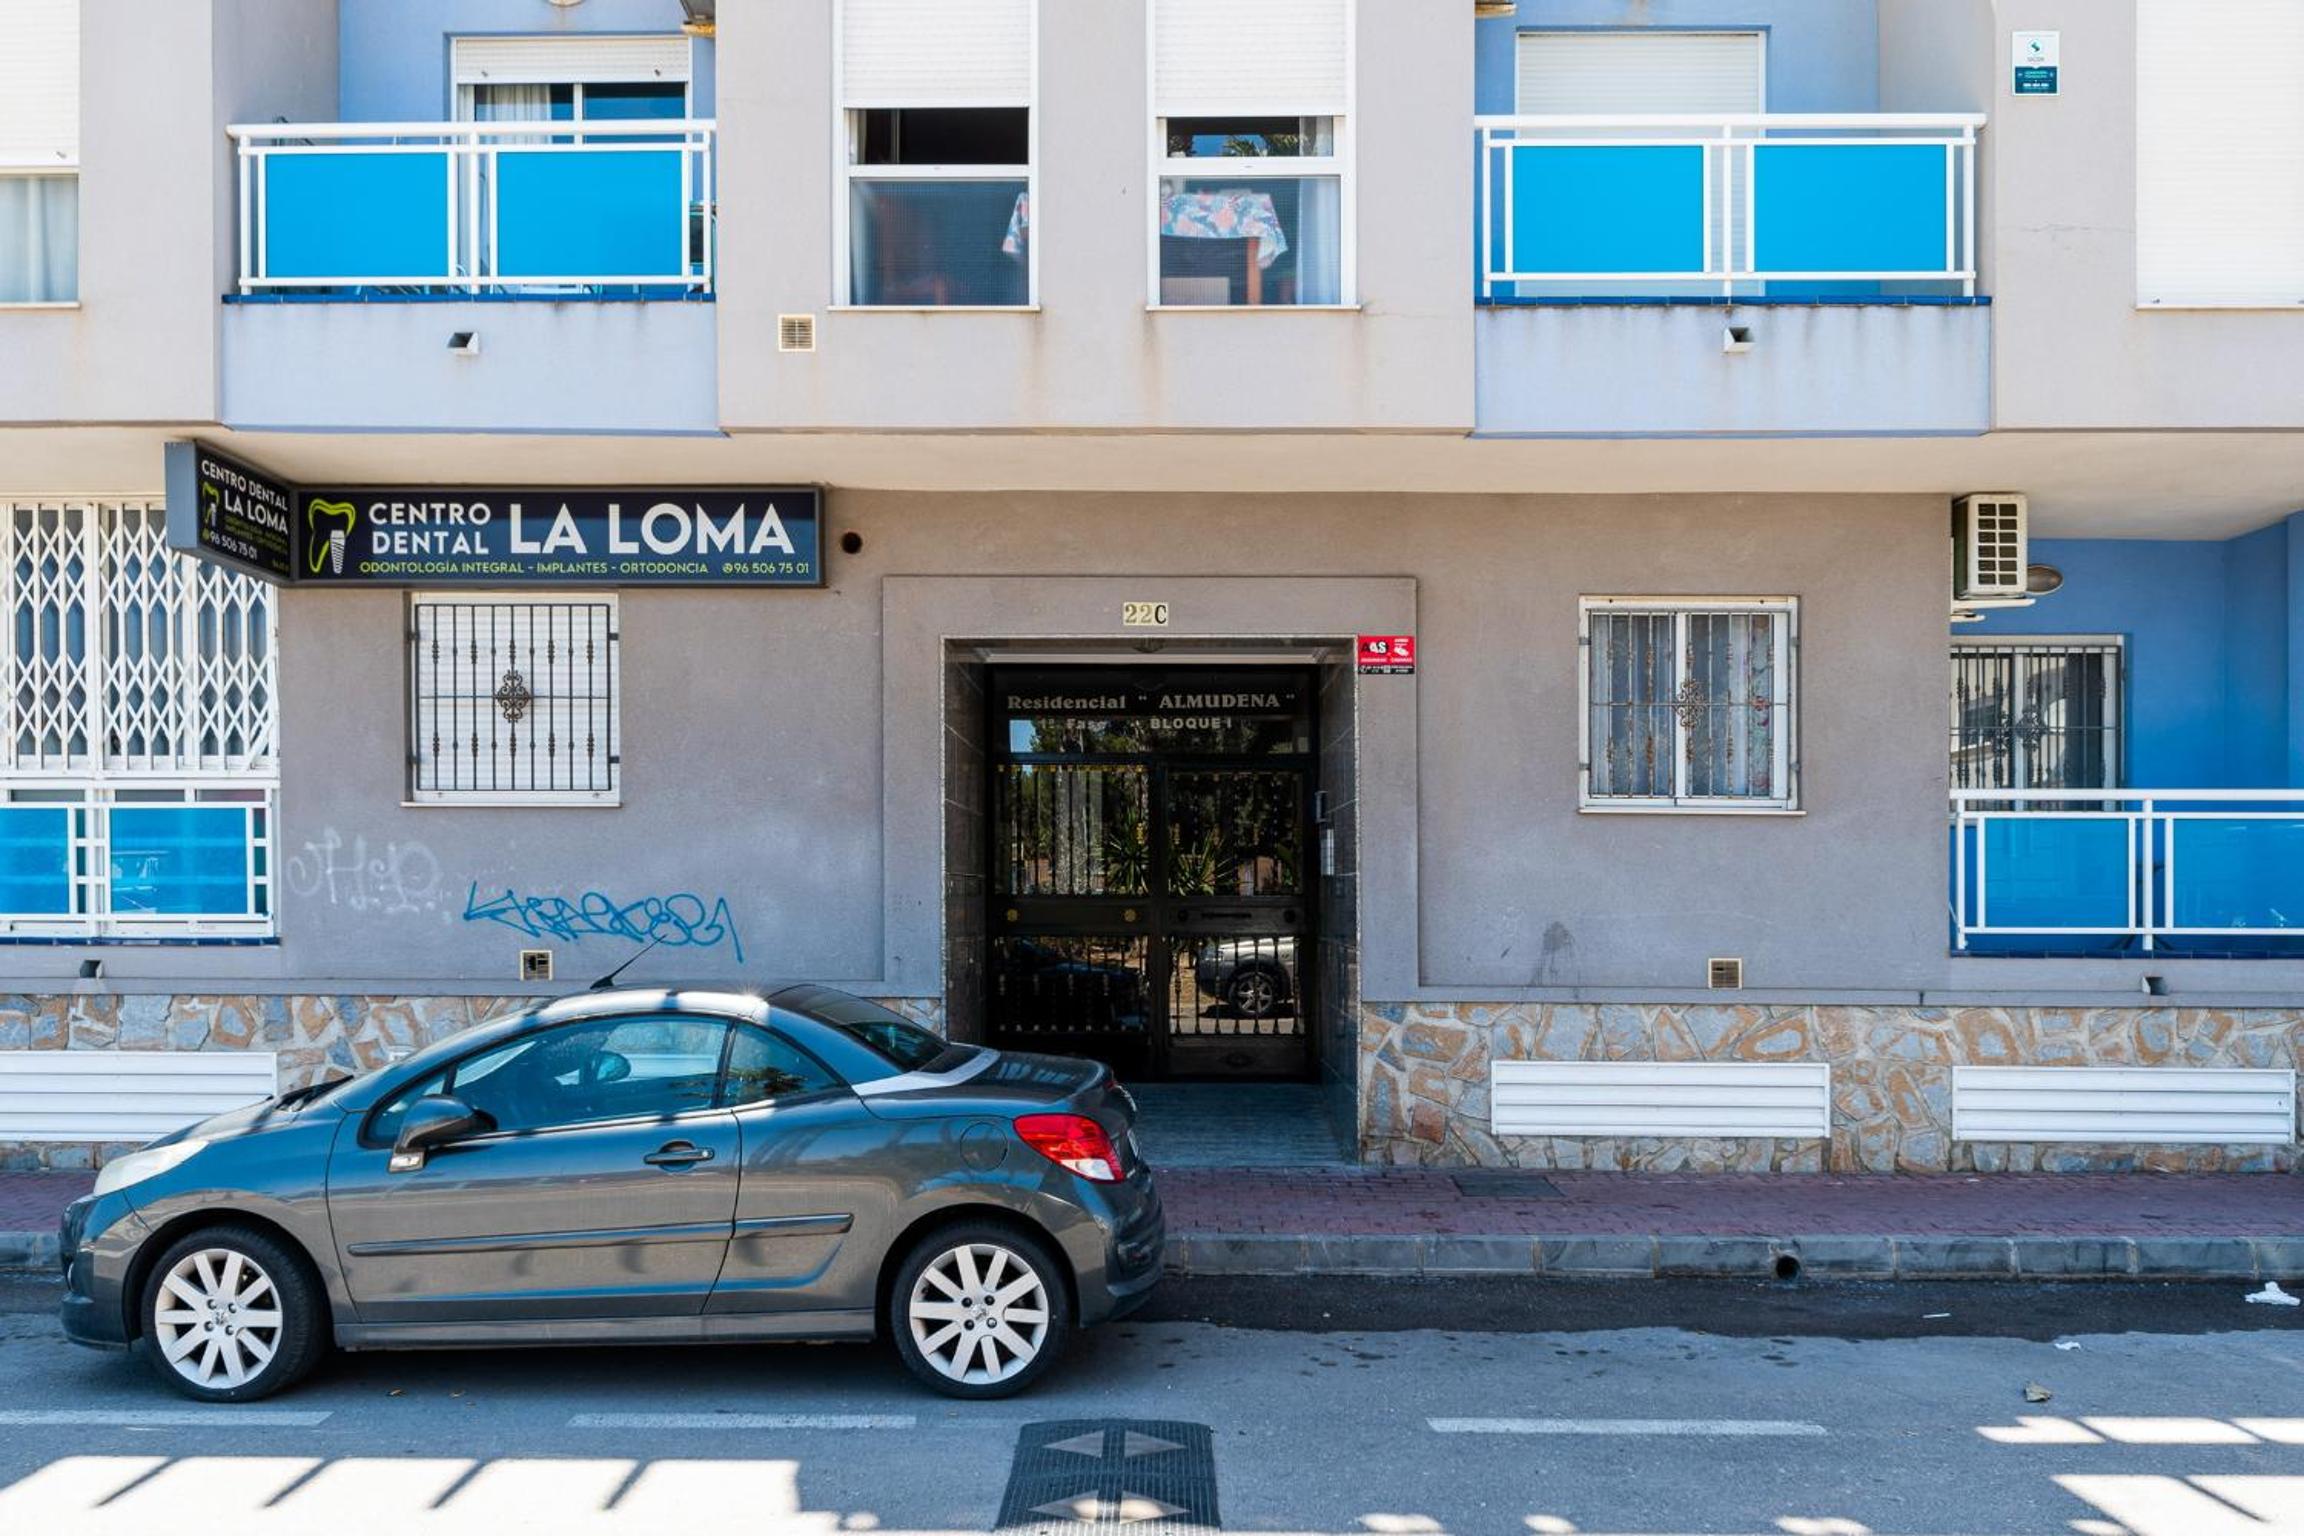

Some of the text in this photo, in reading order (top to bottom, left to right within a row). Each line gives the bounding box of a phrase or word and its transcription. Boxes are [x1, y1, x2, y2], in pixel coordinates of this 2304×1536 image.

[202, 460, 288, 511] CENTRO DENTAL
[224, 489, 288, 534] LA LOMA
[368, 502, 491, 525] CENTRO
[209, 530, 221, 545] 96
[510, 502, 795, 555] LA LOMA
[372, 531, 489, 554] DENTAL
[359, 559, 459, 573] ODONTOLOGÍA
[462, 561, 524, 573] INTEGRAL
[537, 562, 608, 574] IMPLANTES
[620, 562, 708, 574] ORTODONCIA
[733, 562, 809, 574] 96 506 75 01
[1125, 603, 1167, 625] 22C
[1007, 695, 1126, 709] Residencial
[1159, 694, 1280, 709] ALMUDENA
[1150, 718, 1221, 729] BLOQUE
